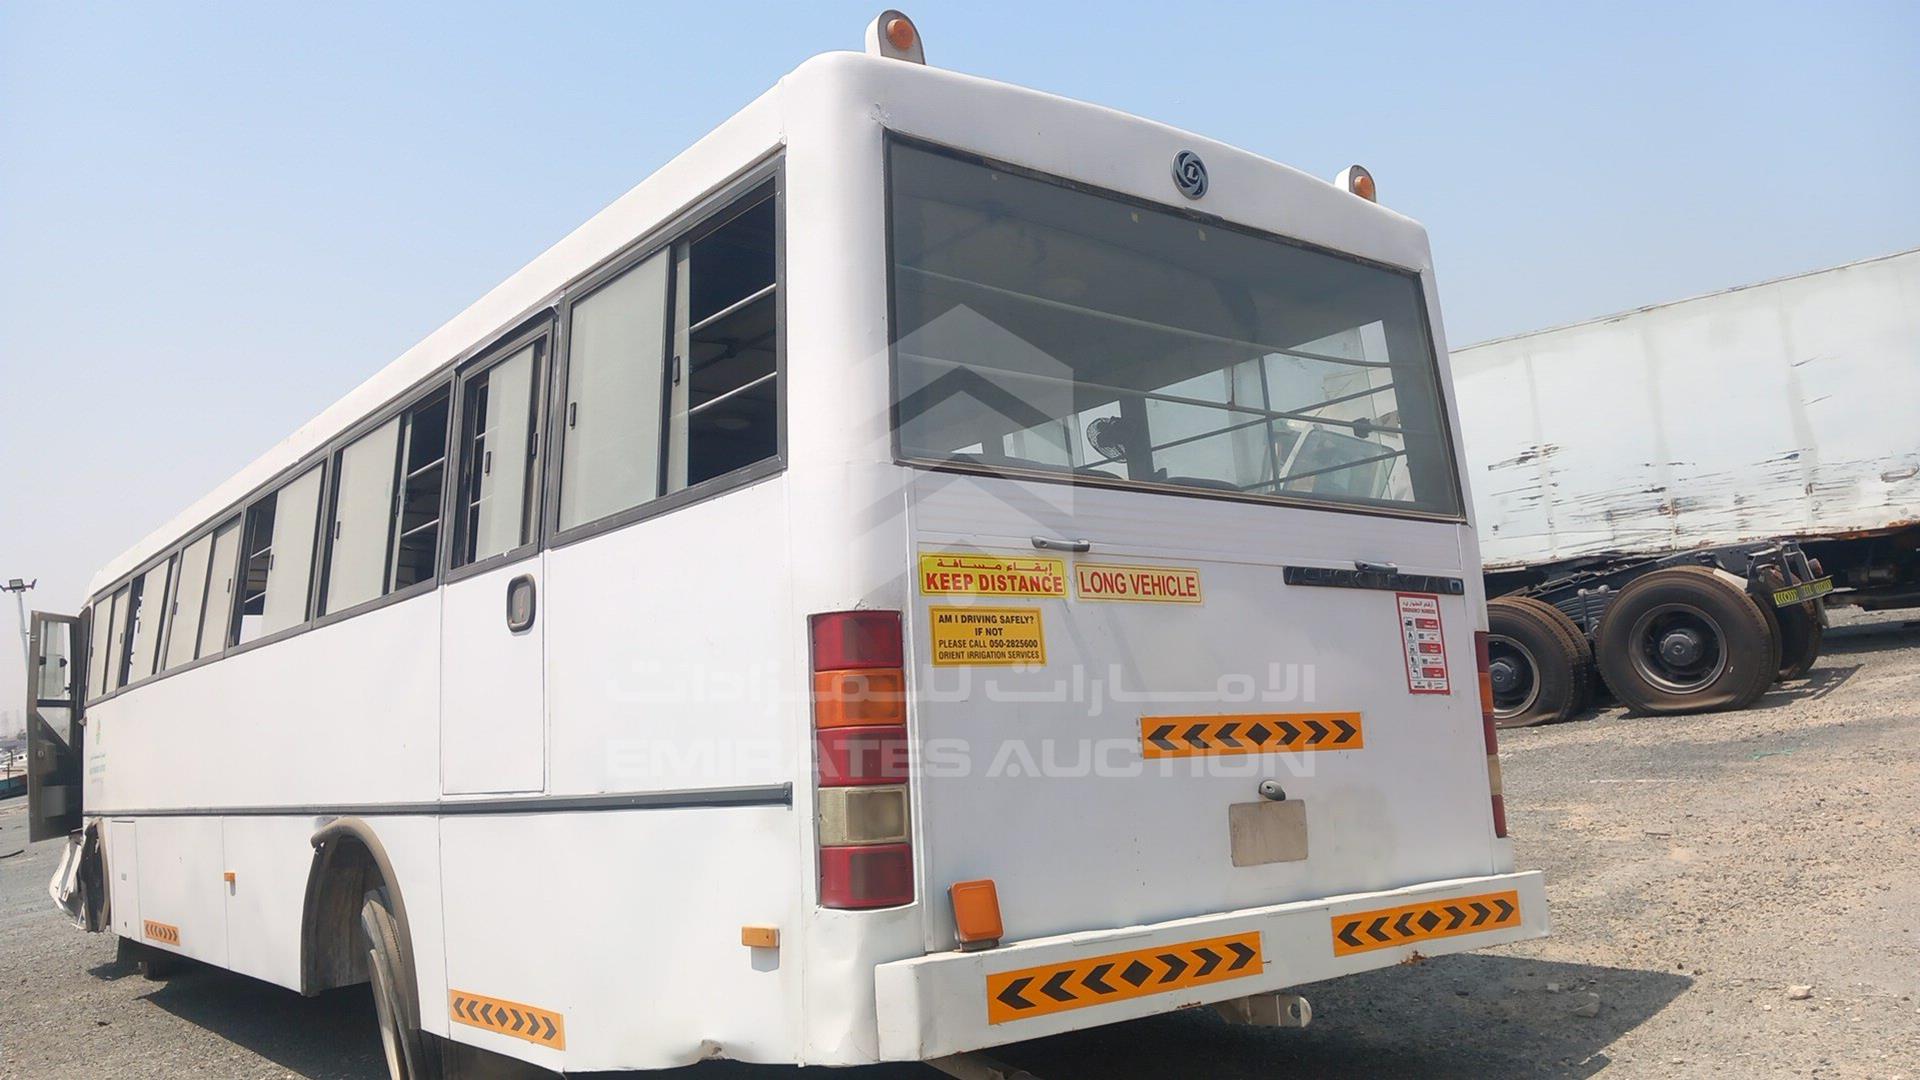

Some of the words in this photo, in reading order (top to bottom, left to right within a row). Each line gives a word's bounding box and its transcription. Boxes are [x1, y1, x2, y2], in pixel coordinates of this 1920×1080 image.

[925, 572, 974, 591] KEEP
[978, 573, 1064, 593] DISTANCE
[1080, 571, 1127, 594] LONG
[1129, 573, 1197, 597] VEHICLE
[938, 614, 953, 624] AM
[954, 614, 959, 624] I
[960, 614, 998, 624] DRIVING
[999, 615, 1035, 625] SAFELY?
[974, 627, 984, 636] IF
[985, 627, 1004, 637] NOT
[938, 639, 967, 649] PLEASE
[968, 639, 988, 649] CALL
[989, 639, 1039, 649] 050-2825600
[938, 650, 965, 660] ORIENT
[966, 650, 1007, 660] IRRIGATION
[1008, 650, 1040, 660] SERVICES
